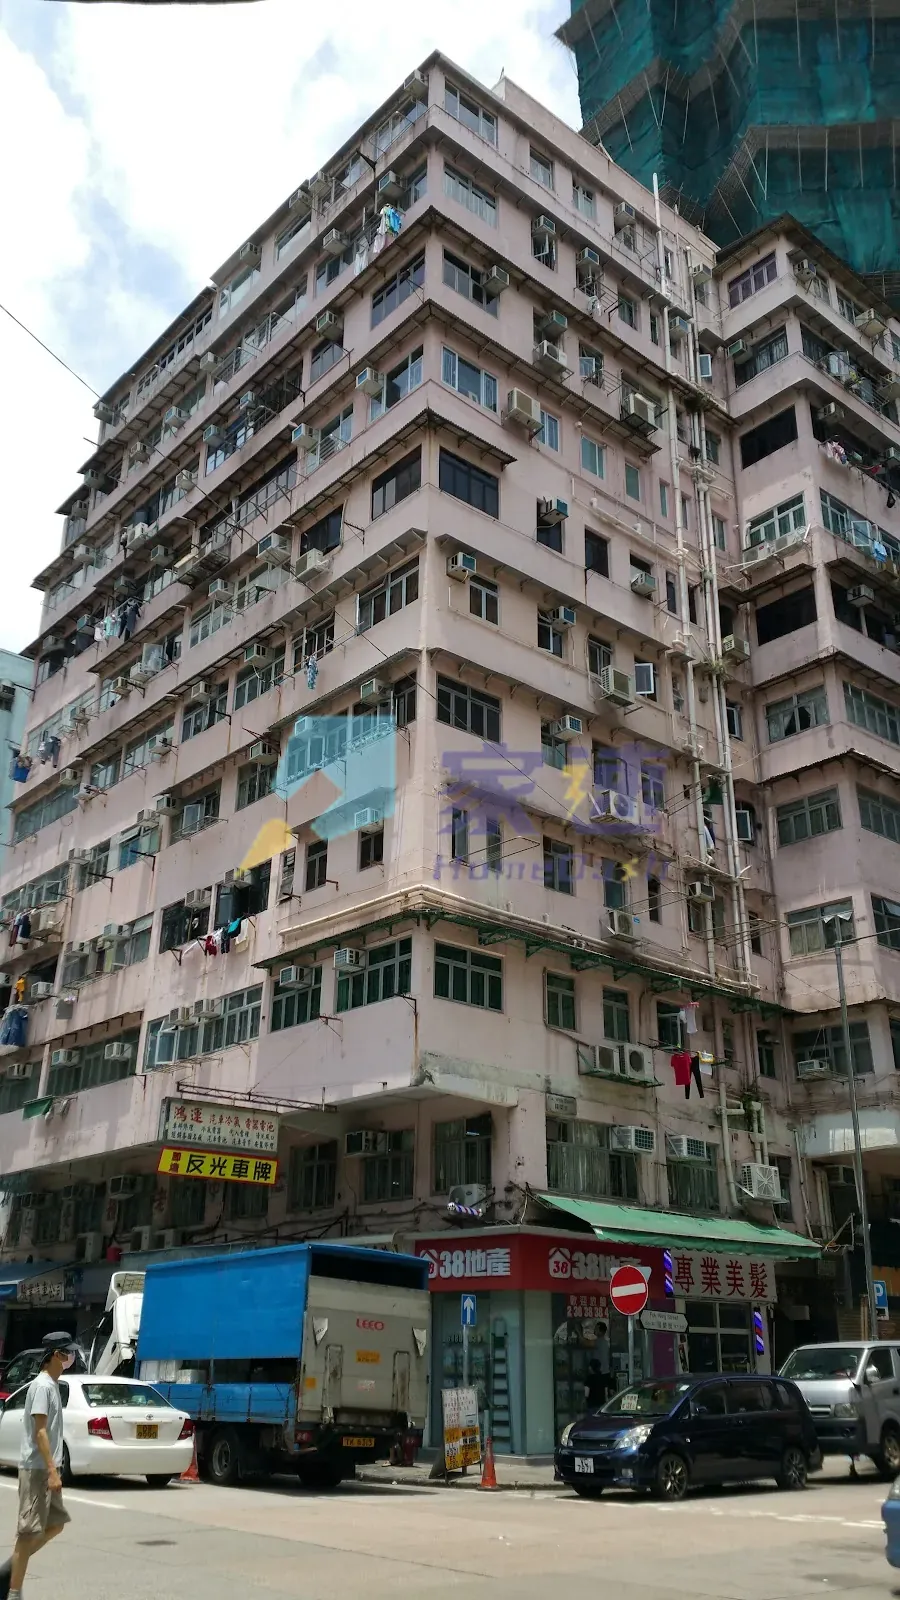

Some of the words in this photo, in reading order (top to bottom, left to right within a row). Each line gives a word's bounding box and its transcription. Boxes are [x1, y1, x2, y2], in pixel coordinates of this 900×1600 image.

[173, 1105, 204, 1124] 鴻運
[209, 1114, 241, 1129] 汽車冷氣
[185, 1154, 272, 1181] 反光車牌
[439, 1248, 511, 1279] 38地產
[552, 1260, 569, 1275] 38
[673, 1254, 768, 1299] 專業美髮
[873, 1283, 884, 1304] P
